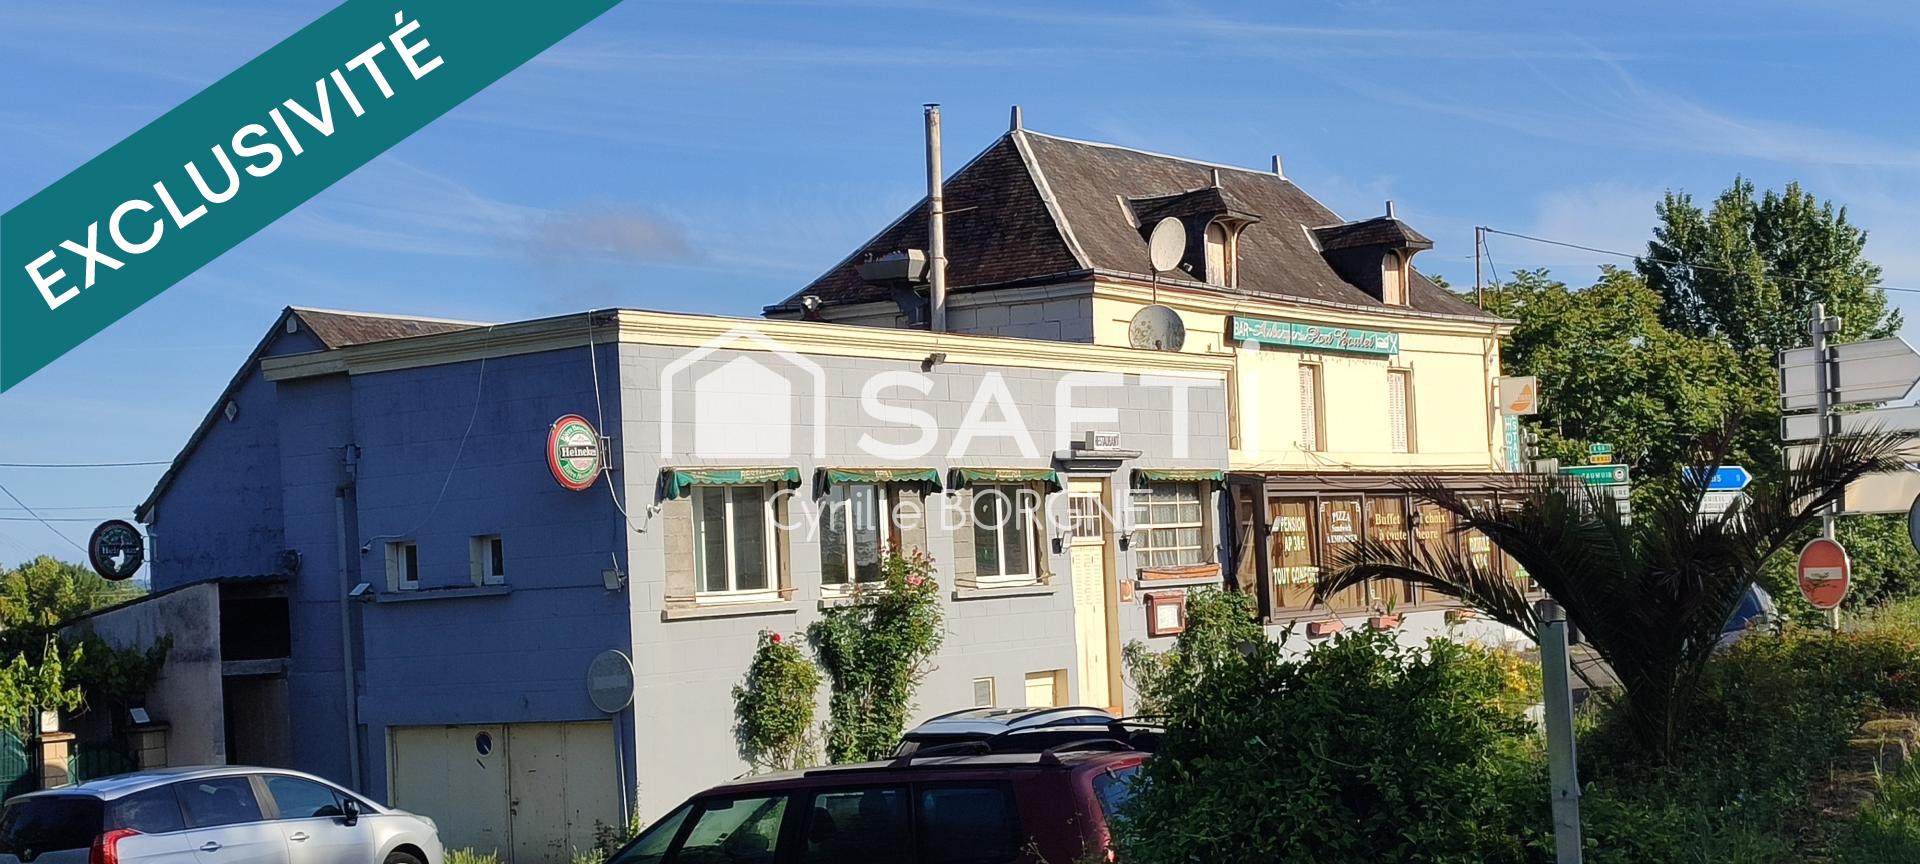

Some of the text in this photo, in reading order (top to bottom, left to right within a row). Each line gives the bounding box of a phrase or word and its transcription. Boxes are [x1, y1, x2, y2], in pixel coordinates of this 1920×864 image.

[1234, 321, 1248, 337] BAR
[1307, 327, 1334, 346] Port
[1280, 516, 1306, 532] PENSION
[1332, 511, 1351, 523] PIZZA
[1375, 513, 1400, 525] Buffet
[1425, 512, 1445, 524] choix
[1273, 567, 1289, 585] TOUT
